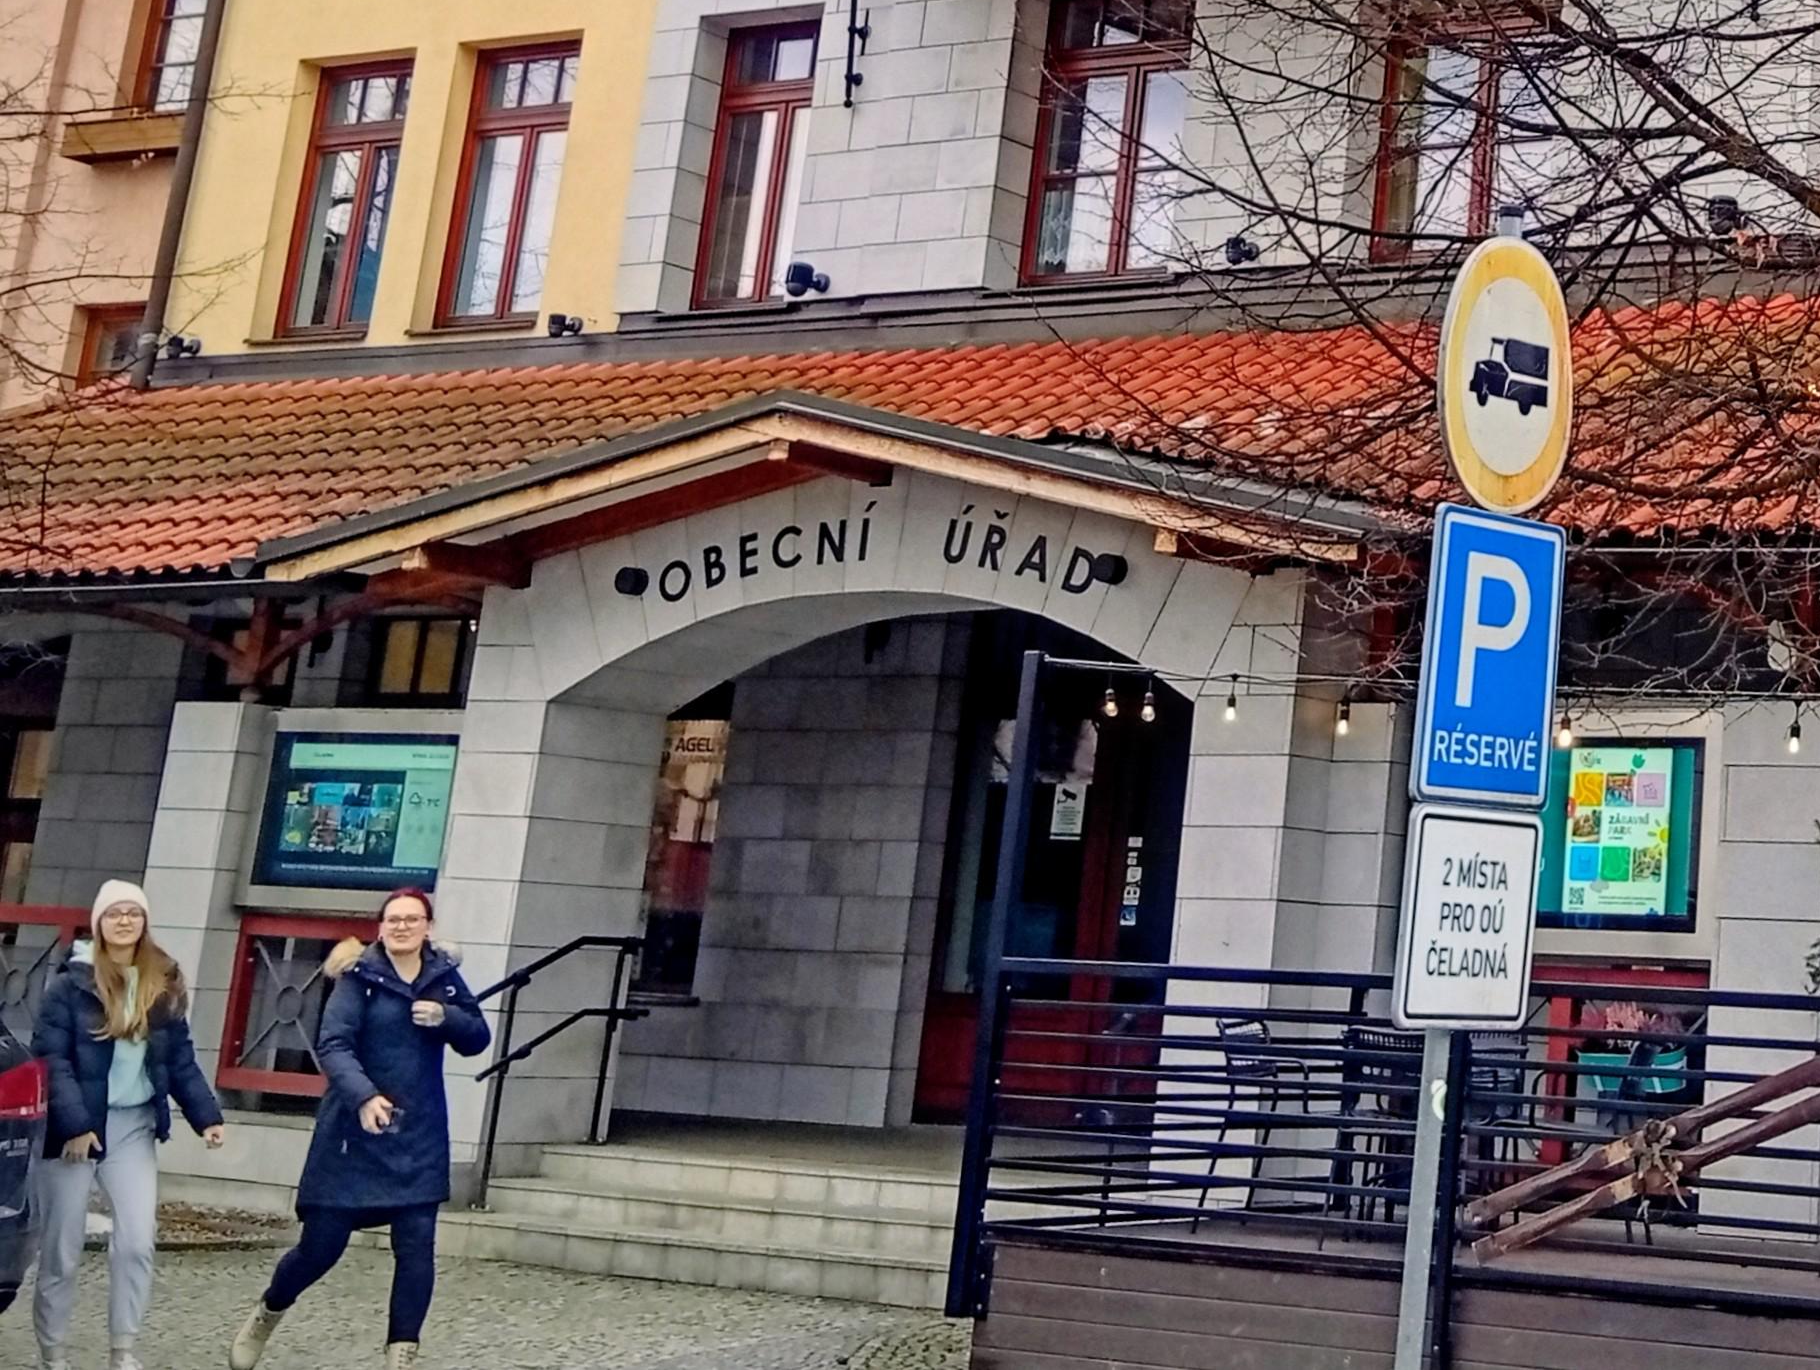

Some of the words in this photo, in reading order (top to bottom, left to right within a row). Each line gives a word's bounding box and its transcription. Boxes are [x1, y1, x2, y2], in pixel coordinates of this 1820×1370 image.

[659, 500, 878, 602] OBECNÍ
[944, 504, 1096, 594] ÚŘAD
[1454, 551, 1531, 708] P
[675, 737, 714, 752] AGEL
[1433, 723, 1538, 771] RÉSERVÉ
[1442, 857, 1453, 886] 2
[1457, 852, 1508, 890] MÍSTA
[1440, 902, 1475, 933] PRO
[1480, 899, 1504, 933] OÚ
[1426, 939, 1508, 979] ČELADNÁ
